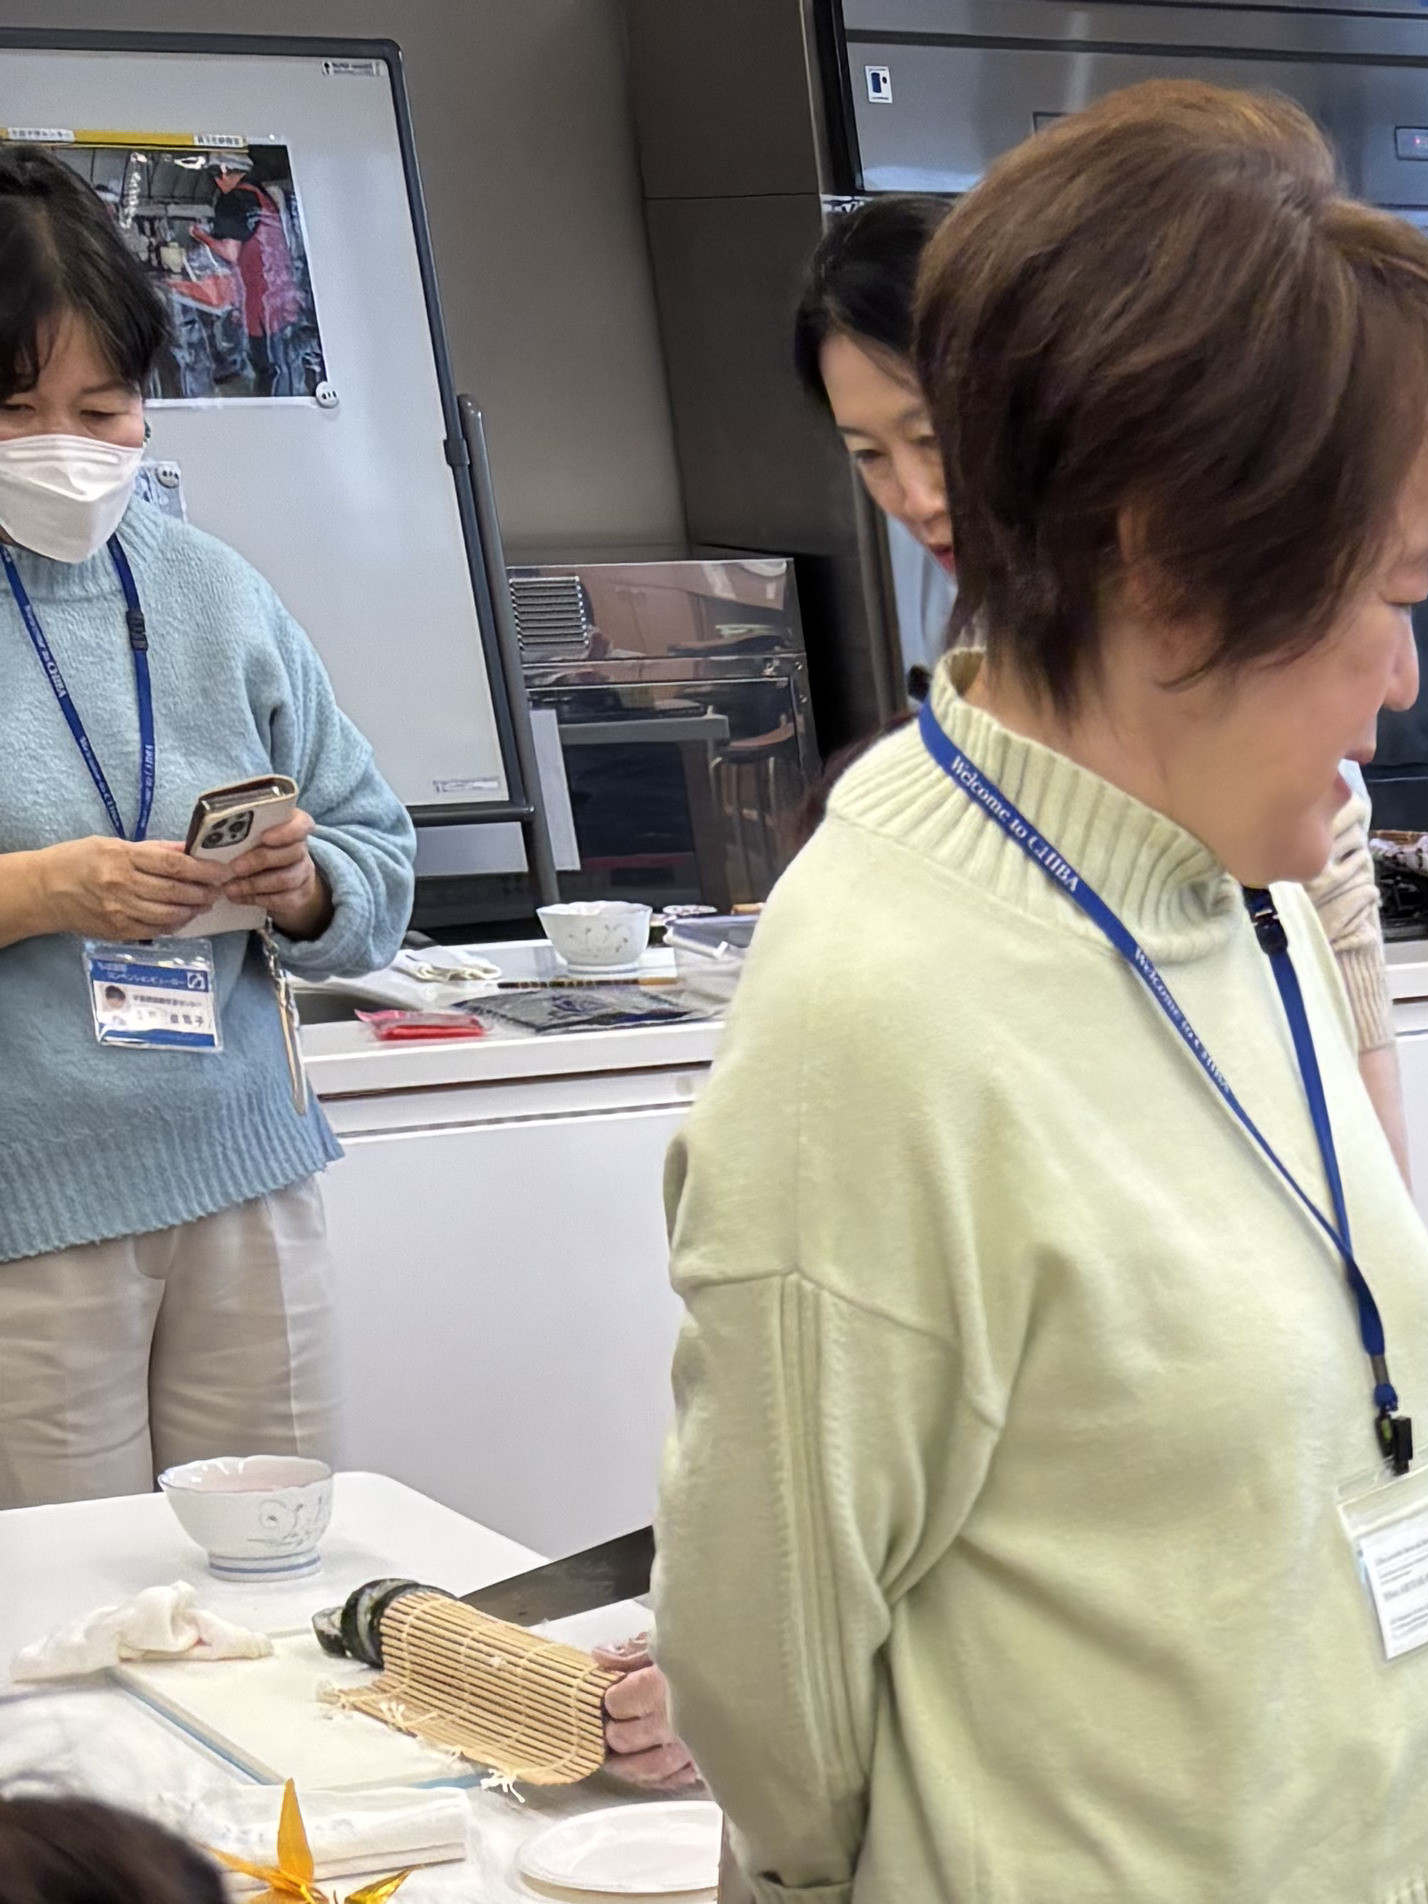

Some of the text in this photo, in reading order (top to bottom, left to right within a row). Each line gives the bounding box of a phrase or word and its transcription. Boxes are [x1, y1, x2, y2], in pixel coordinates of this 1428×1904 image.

[950, 755, 1081, 892] Welcome to CHIBA
